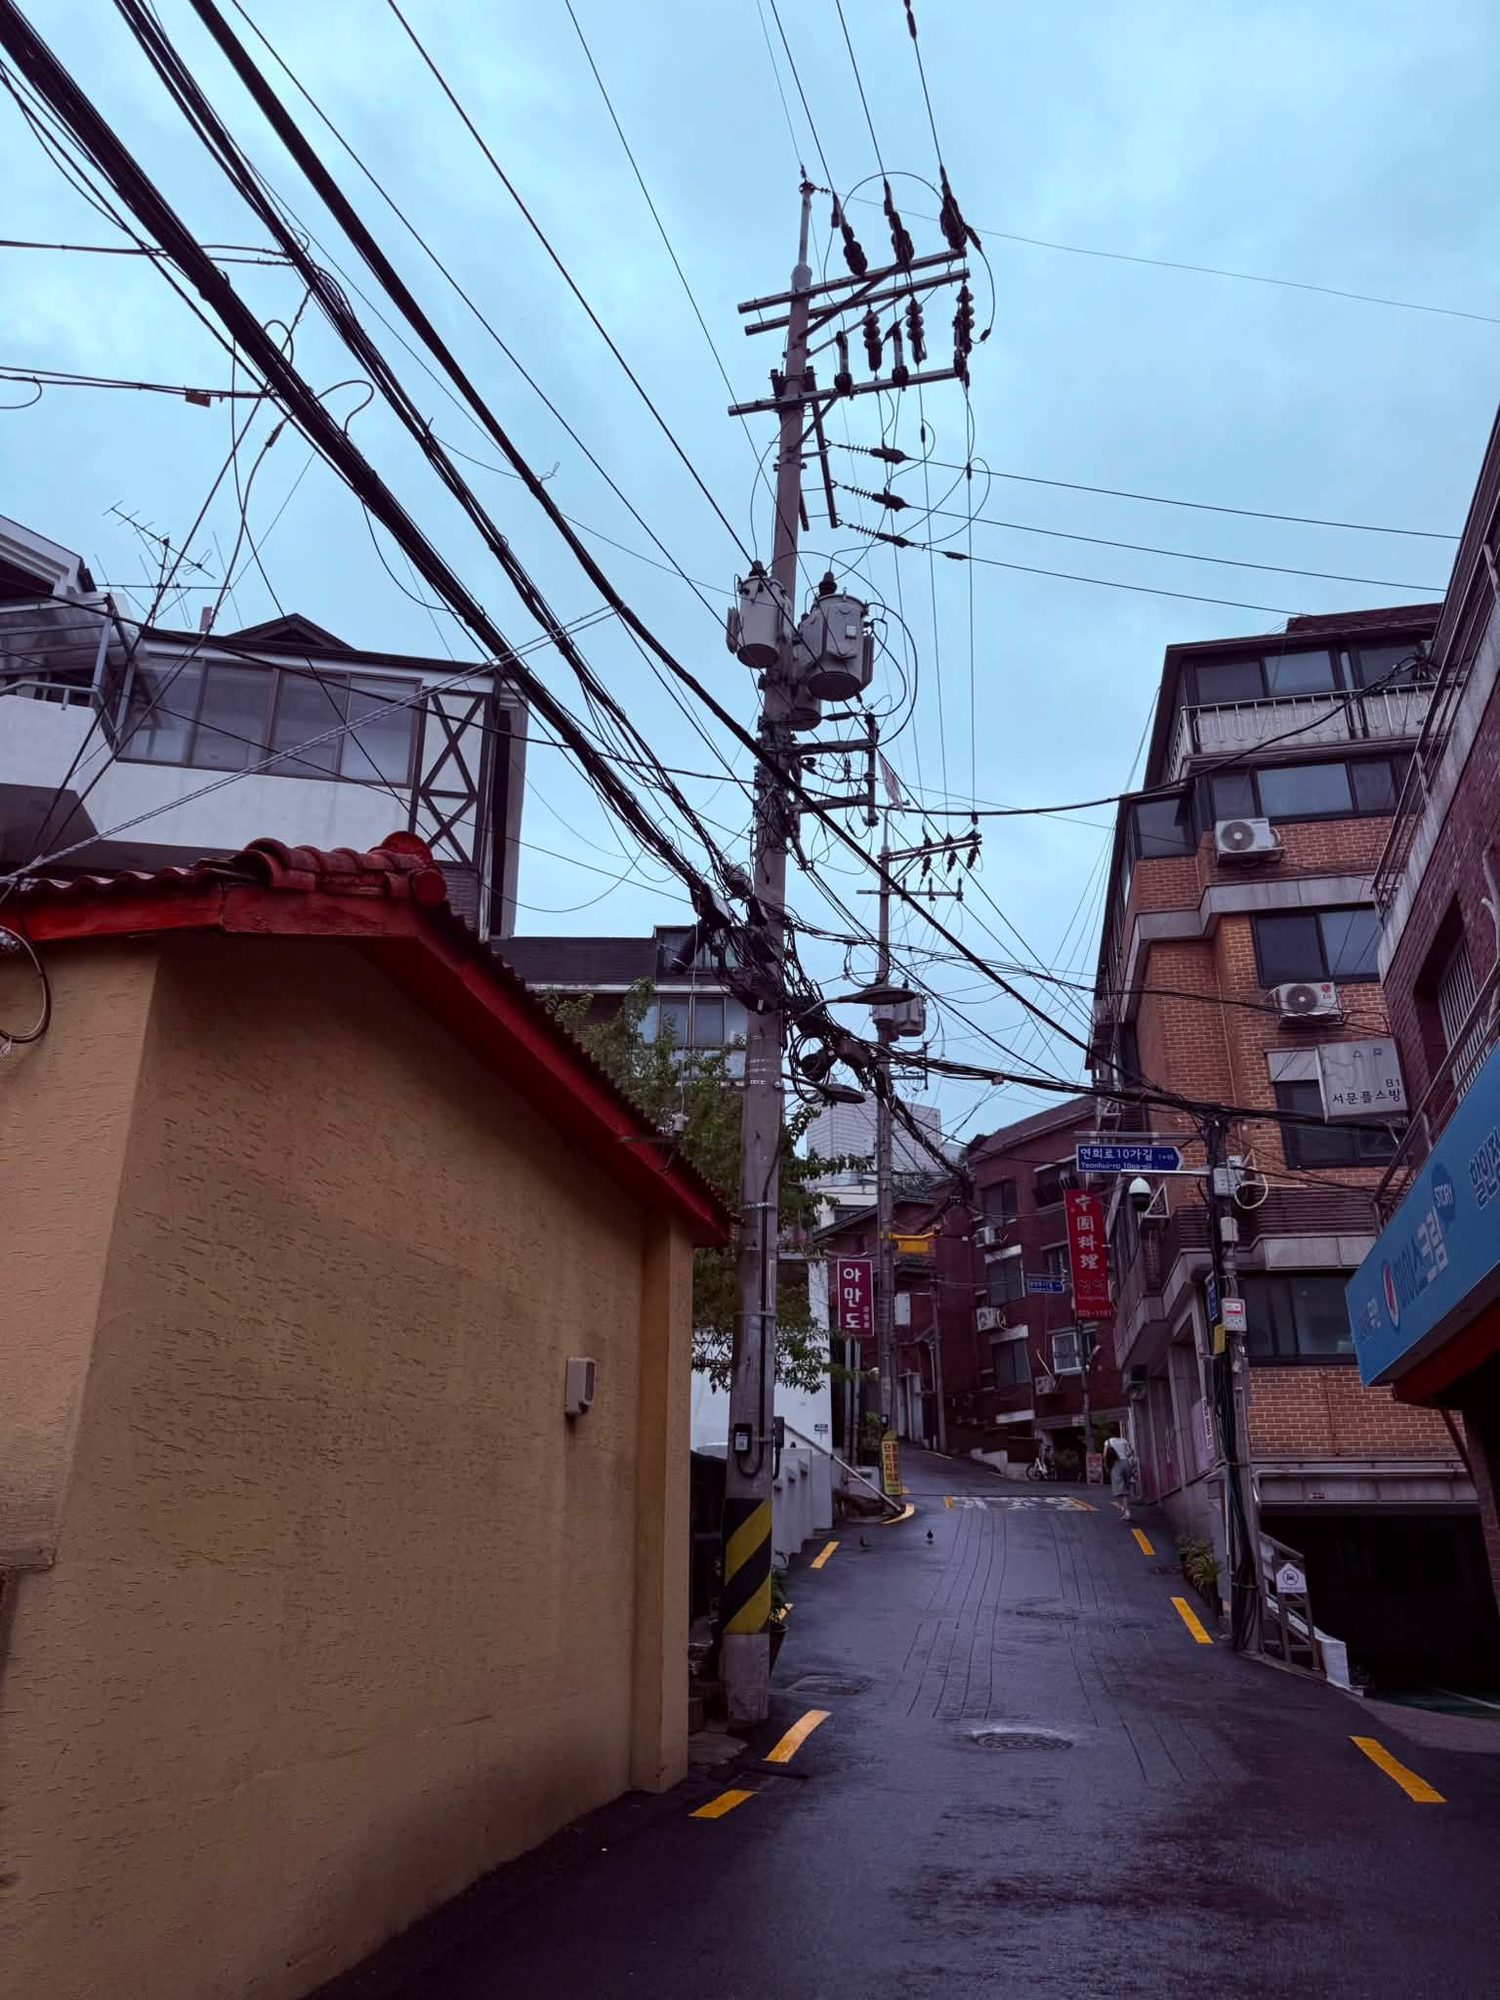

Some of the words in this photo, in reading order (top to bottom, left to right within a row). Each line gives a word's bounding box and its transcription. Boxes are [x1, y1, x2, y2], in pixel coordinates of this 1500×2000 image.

[1385, 1078, 1400, 1088] B1
[1332, 1088, 1401, 1106] 서문플스방
[1080, 1147, 1153, 1161] 연희로10가길
[843, 1267, 863, 1329] 아만도
